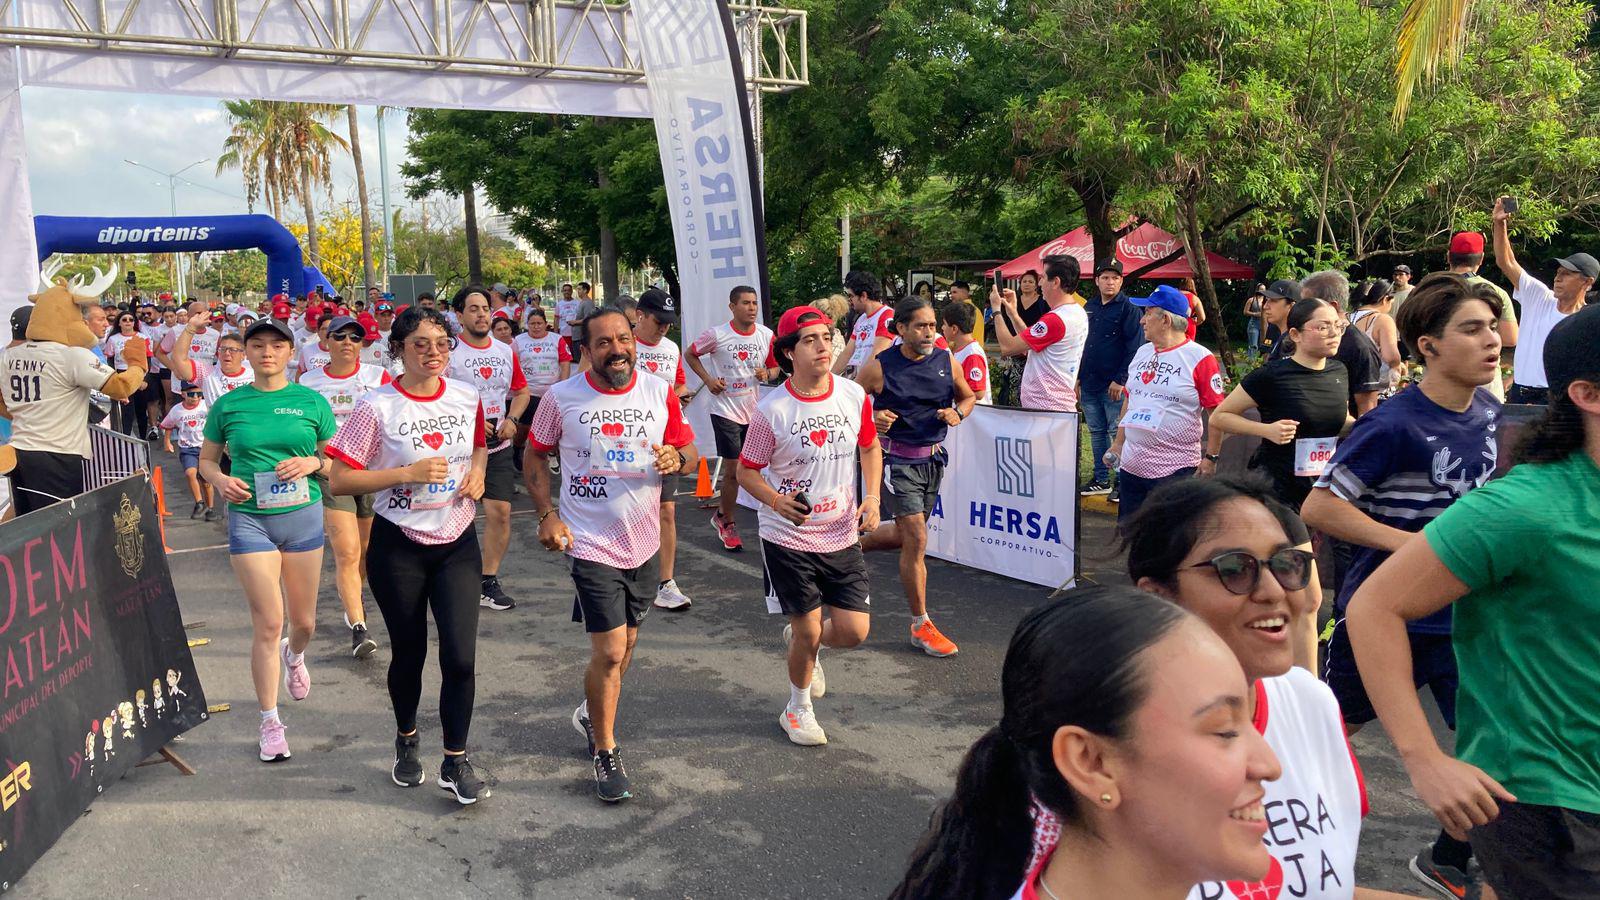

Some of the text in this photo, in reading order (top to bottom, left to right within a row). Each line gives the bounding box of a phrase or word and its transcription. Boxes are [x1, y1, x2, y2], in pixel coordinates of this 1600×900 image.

[98, 226, 210, 245] dportenis
[9, 359, 46, 373] VENNY
[464, 356, 507, 369] CARRERA
[10, 374, 42, 403] 911
[274, 407, 304, 416] CESAD
[486, 405, 501, 415] 095
[579, 408, 655, 425] CARRERA
[1131, 412, 1152, 422] 016
[398, 414, 468, 436] CARRERA
[790, 414, 852, 436] CARRERA
[606, 449, 635, 463] 033
[1309, 450, 1332, 463] 080
[270, 482, 297, 494] 023
[429, 479, 456, 494] 032
[569, 485, 608, 498] DONA
[813, 500, 837, 514] 022
[969, 501, 1061, 544] HERSA
[980, 536, 1052, 558] CORPORATIVO
